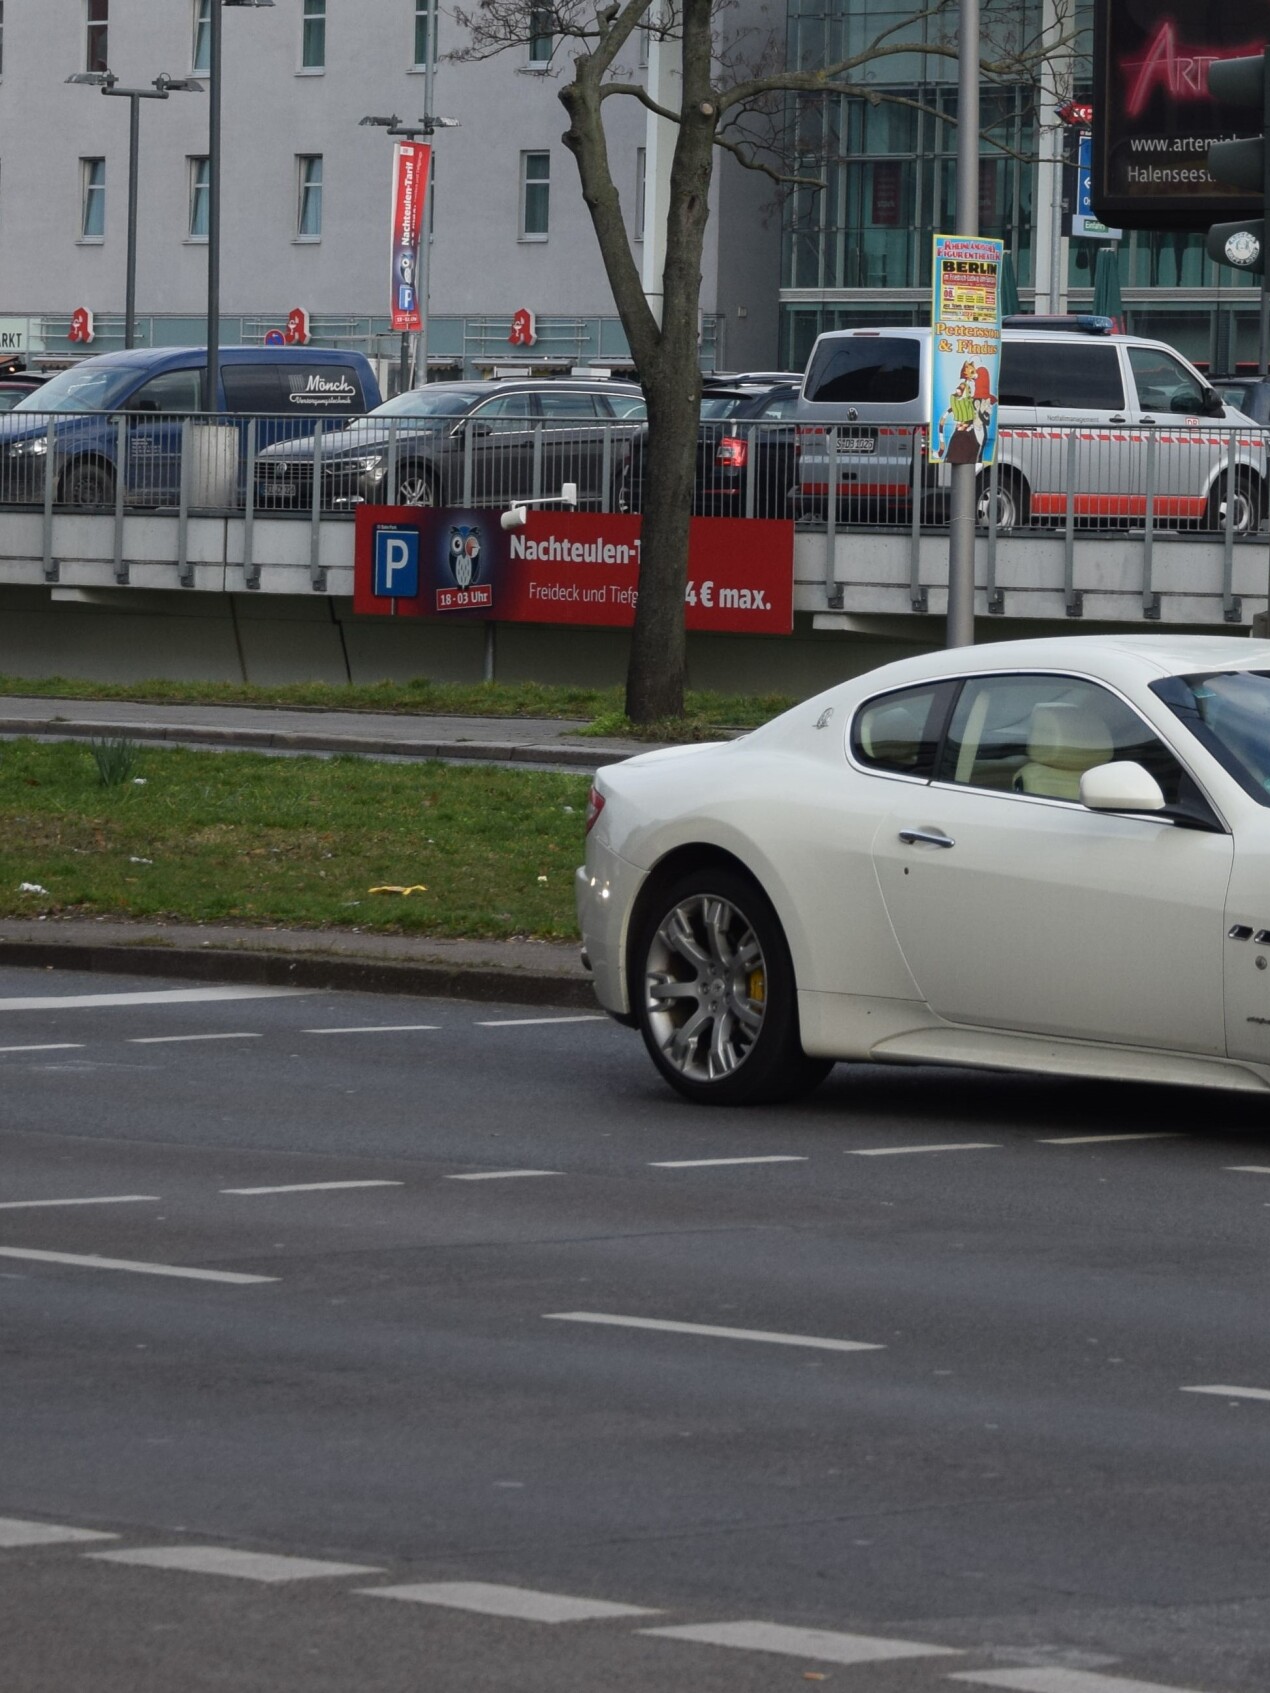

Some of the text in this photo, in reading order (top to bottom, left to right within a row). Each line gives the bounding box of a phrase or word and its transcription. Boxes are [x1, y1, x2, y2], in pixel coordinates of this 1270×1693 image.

[402, 161, 414, 246] Nachteulen-Tarif
[942, 261, 997, 275] BERLIN
[404, 289, 412, 308] P
[935, 322, 1001, 339] Pettersson
[0, 333, 22, 348] RKT
[939, 339, 998, 354] & Findus
[305, 374, 350, 391] Mönch
[385, 538, 409, 589] P
[440, 594, 452, 606] 18
[457, 592, 469, 605] 03
[470, 591, 488, 602] Uhr
[529, 582, 638, 608] Freideck und Tiefg
[719, 587, 772, 610] max.
